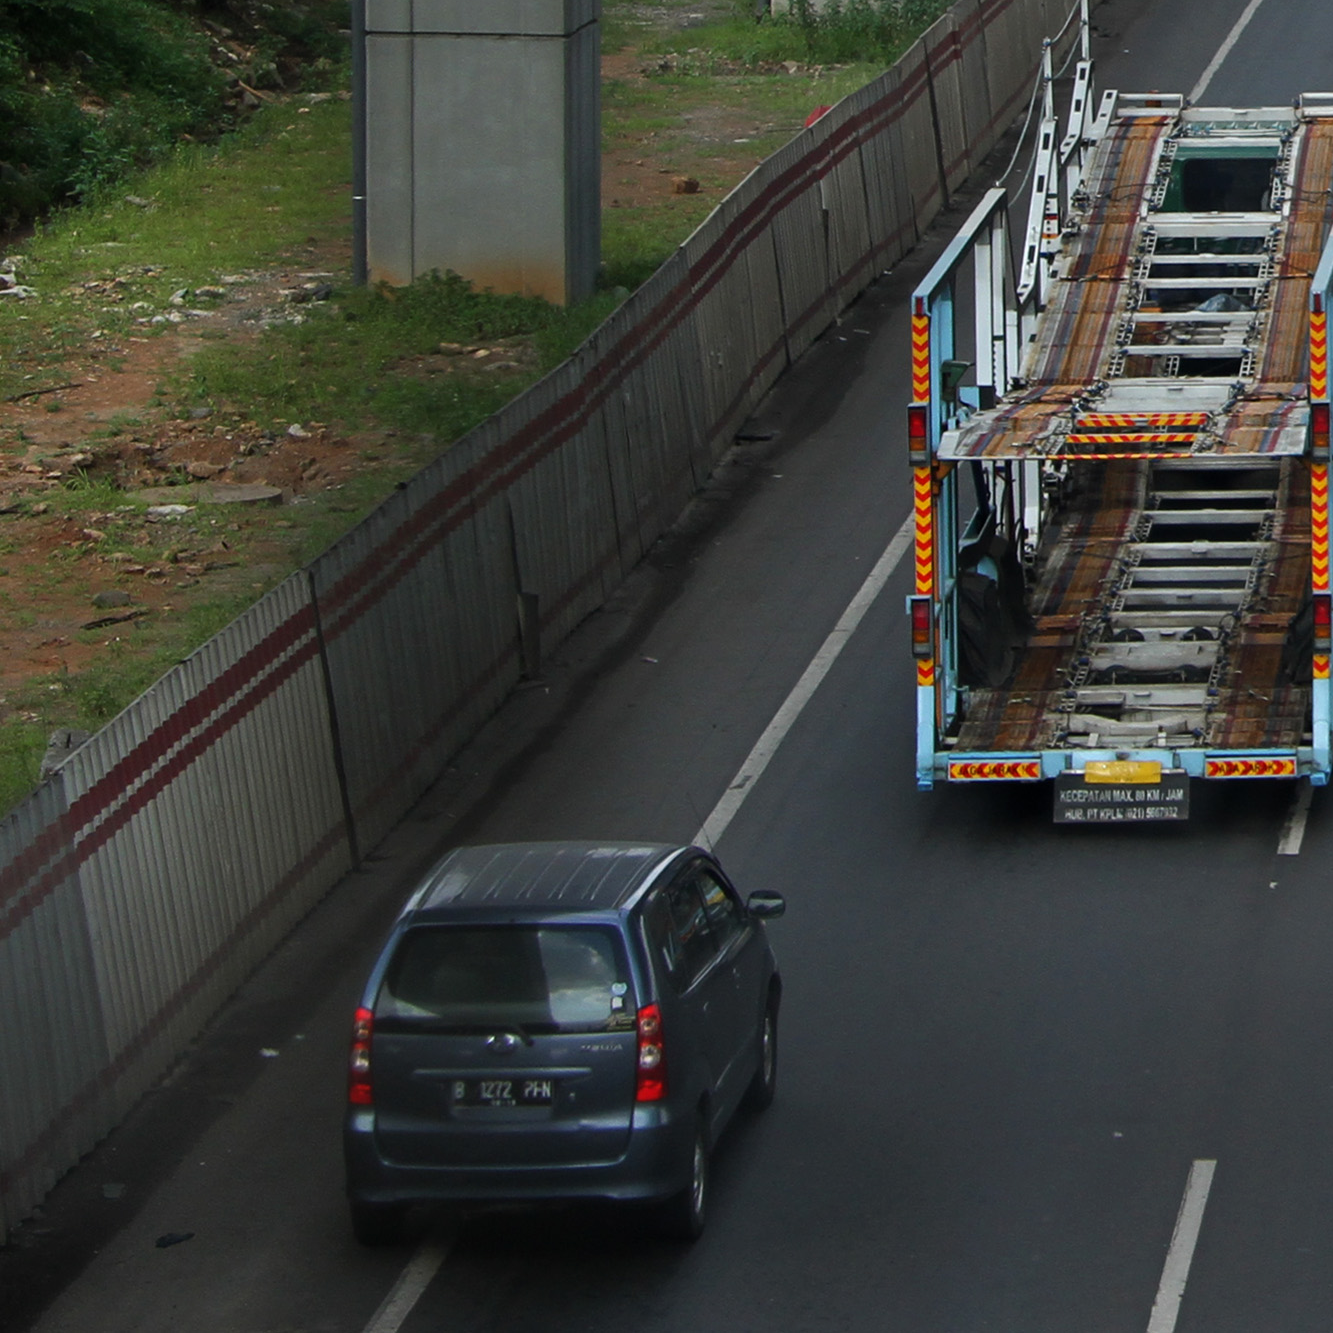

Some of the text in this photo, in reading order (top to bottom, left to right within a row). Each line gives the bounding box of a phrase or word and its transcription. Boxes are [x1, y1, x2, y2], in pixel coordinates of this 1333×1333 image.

[987, 765, 1018, 776] JARAK
[1060, 789, 1111, 802] KECEPATAN
[1135, 790, 1145, 802] 80
[1146, 789, 1160, 802] KM
[1165, 789, 1184, 800] JAM
[1065, 808, 1086, 820] HUB.
[455, 1081, 466, 1098] B
[480, 1081, 512, 1099] 1272
